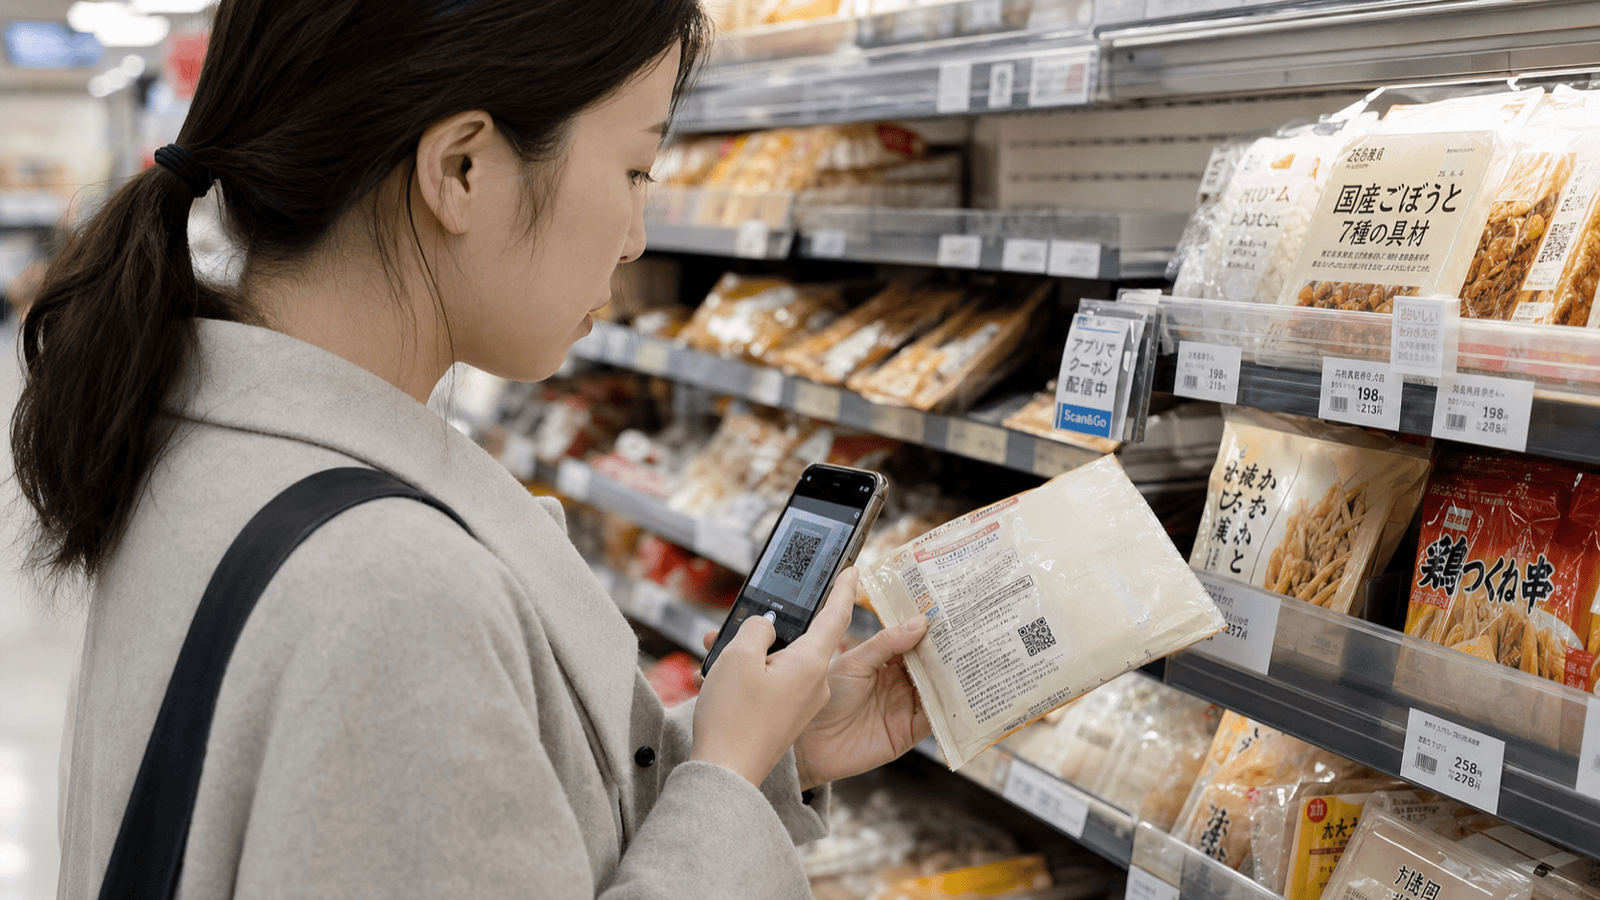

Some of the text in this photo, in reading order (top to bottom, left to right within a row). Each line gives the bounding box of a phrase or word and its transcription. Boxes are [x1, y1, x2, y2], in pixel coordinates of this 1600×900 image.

[1333, 183, 1462, 215] 国産ごぼうと
[1339, 220, 1430, 247] 7種の具材
[1072, 338, 1117, 358] アプリで
[1069, 356, 1113, 377] クーポン
[1065, 375, 1108, 398] 配信中
[1064, 409, 1107, 428] Scan&Go
[1417, 534, 1554, 615] 鶏つくね串
